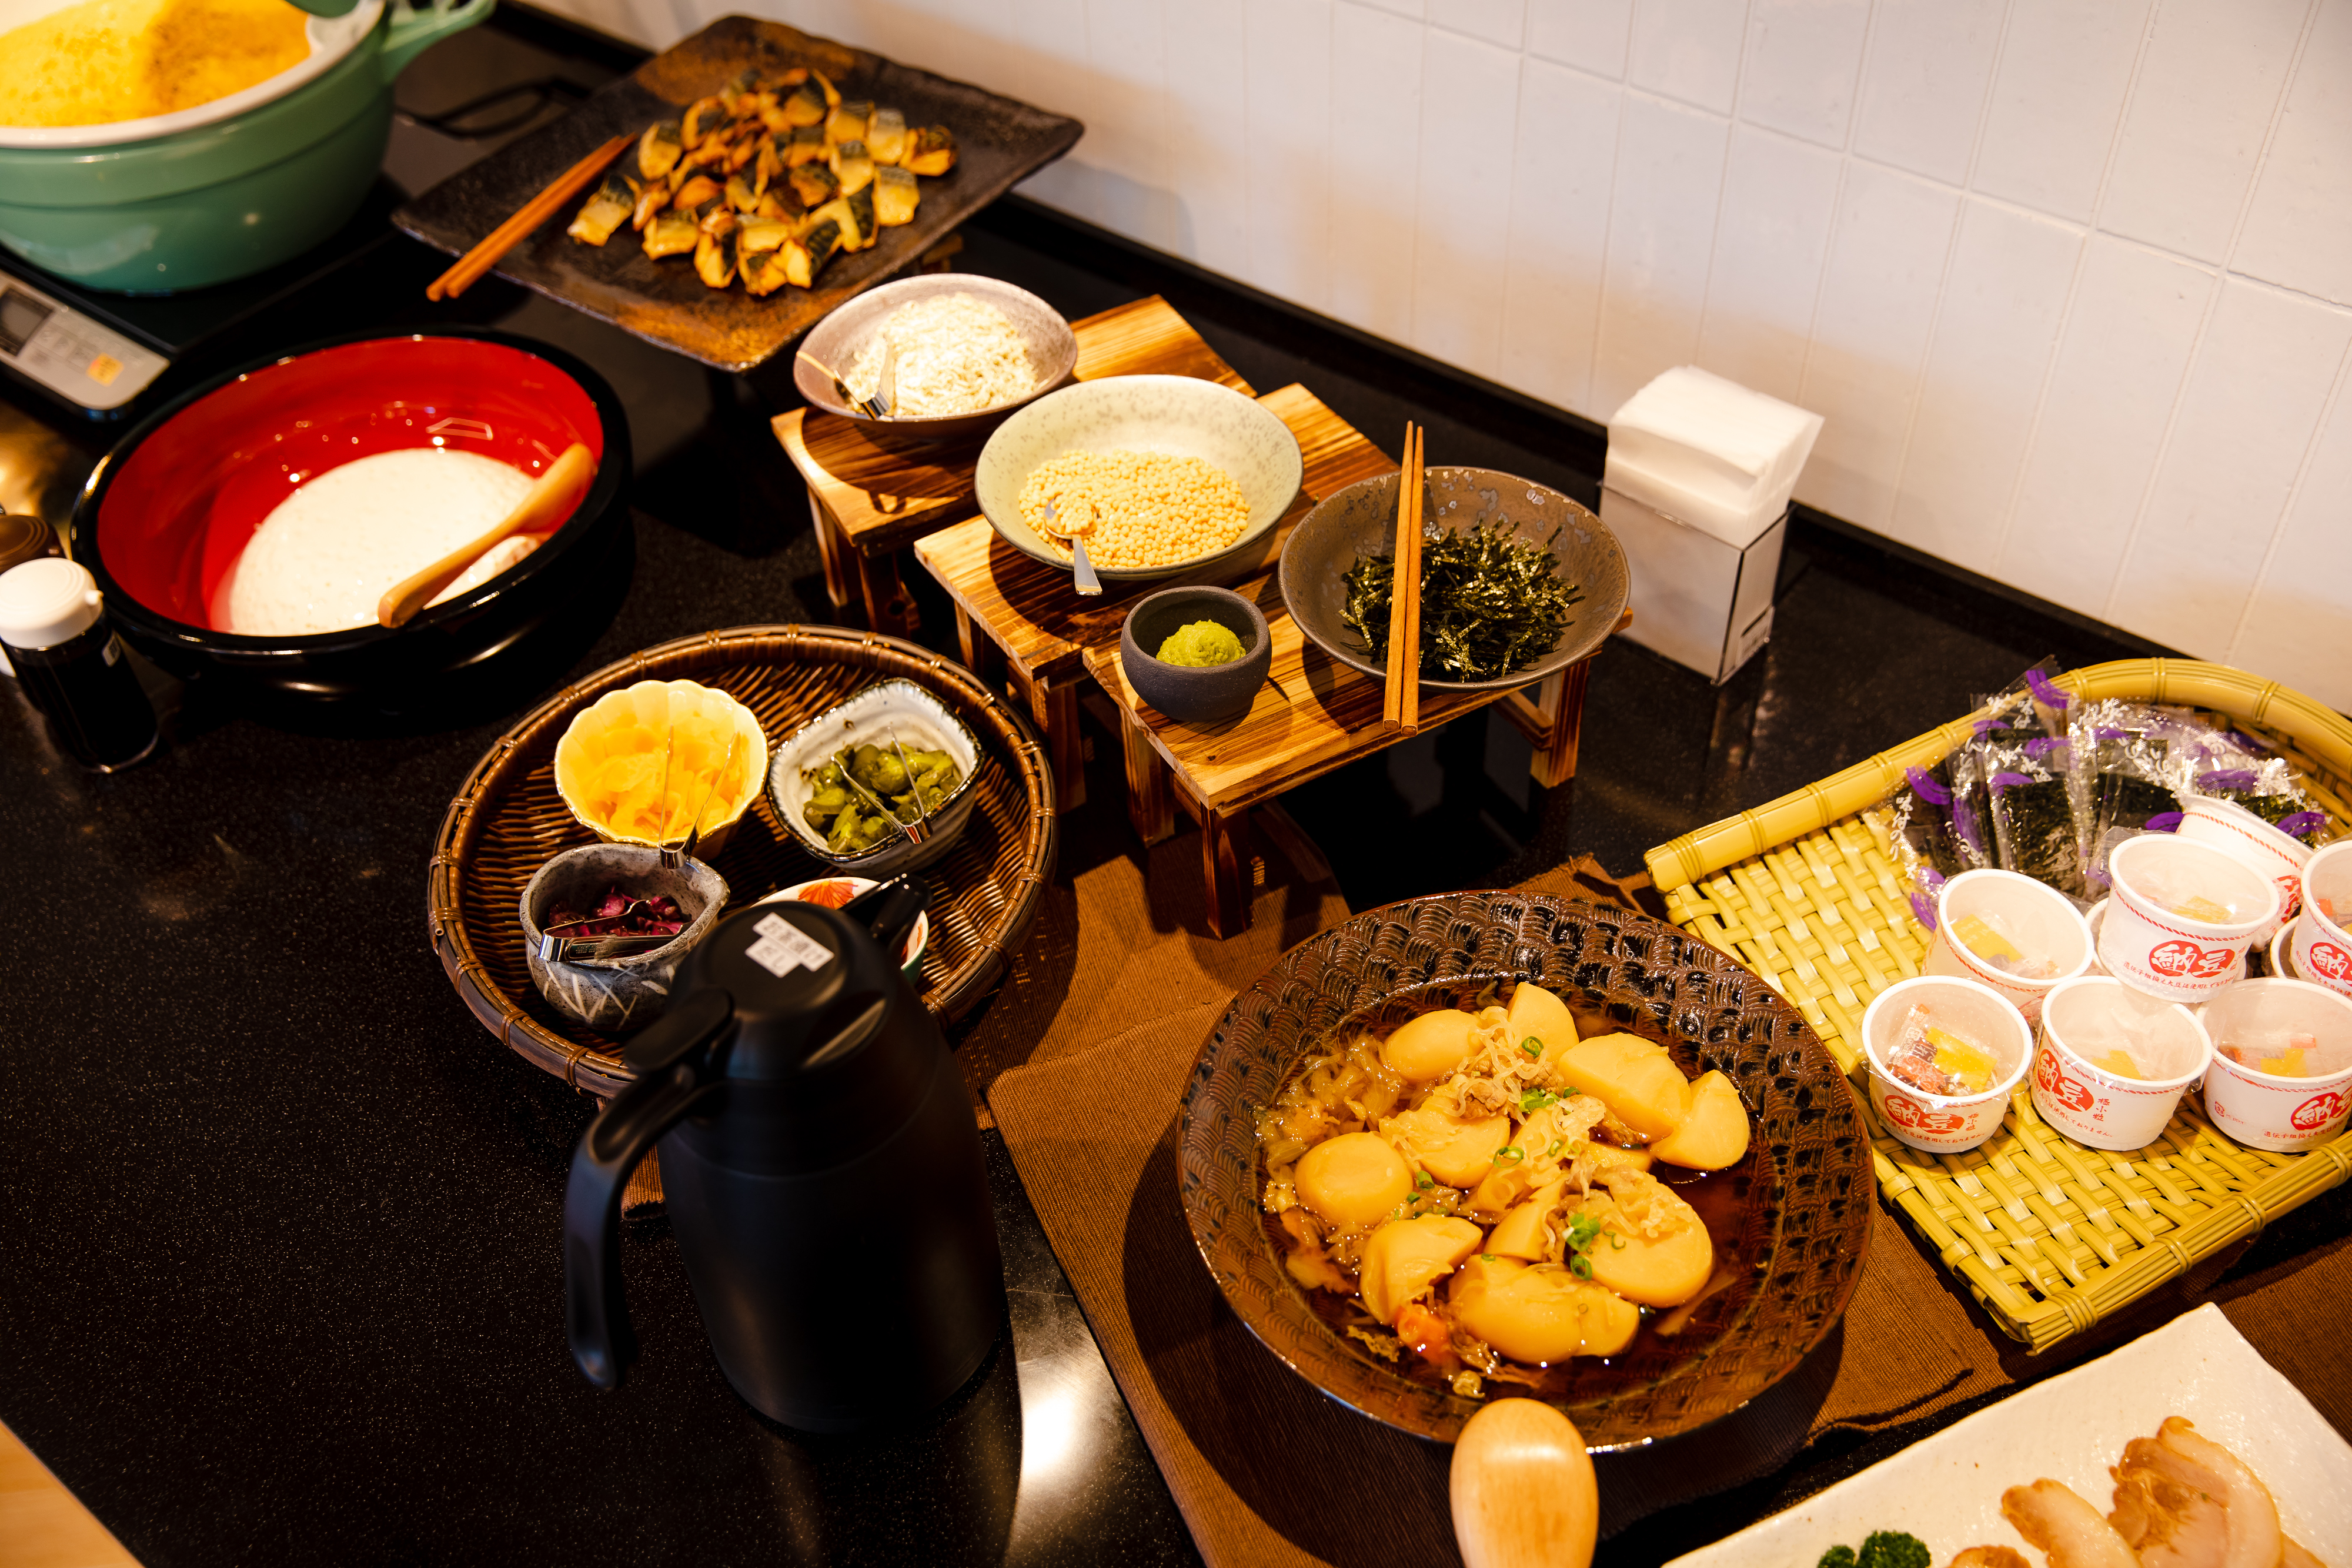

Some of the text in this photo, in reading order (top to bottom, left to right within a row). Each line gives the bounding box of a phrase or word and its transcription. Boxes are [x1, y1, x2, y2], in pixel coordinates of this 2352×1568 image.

[2149, 941, 2235, 978] 納豆
[2310, 942, 2352, 986] 納
[2037, 1049, 2094, 1112] 納豆
[1885, 1095, 1965, 1135] 納豆
[1965, 1112, 1980, 1132] 極小粒
[2092, 1098, 2110, 1122] 極小粒
